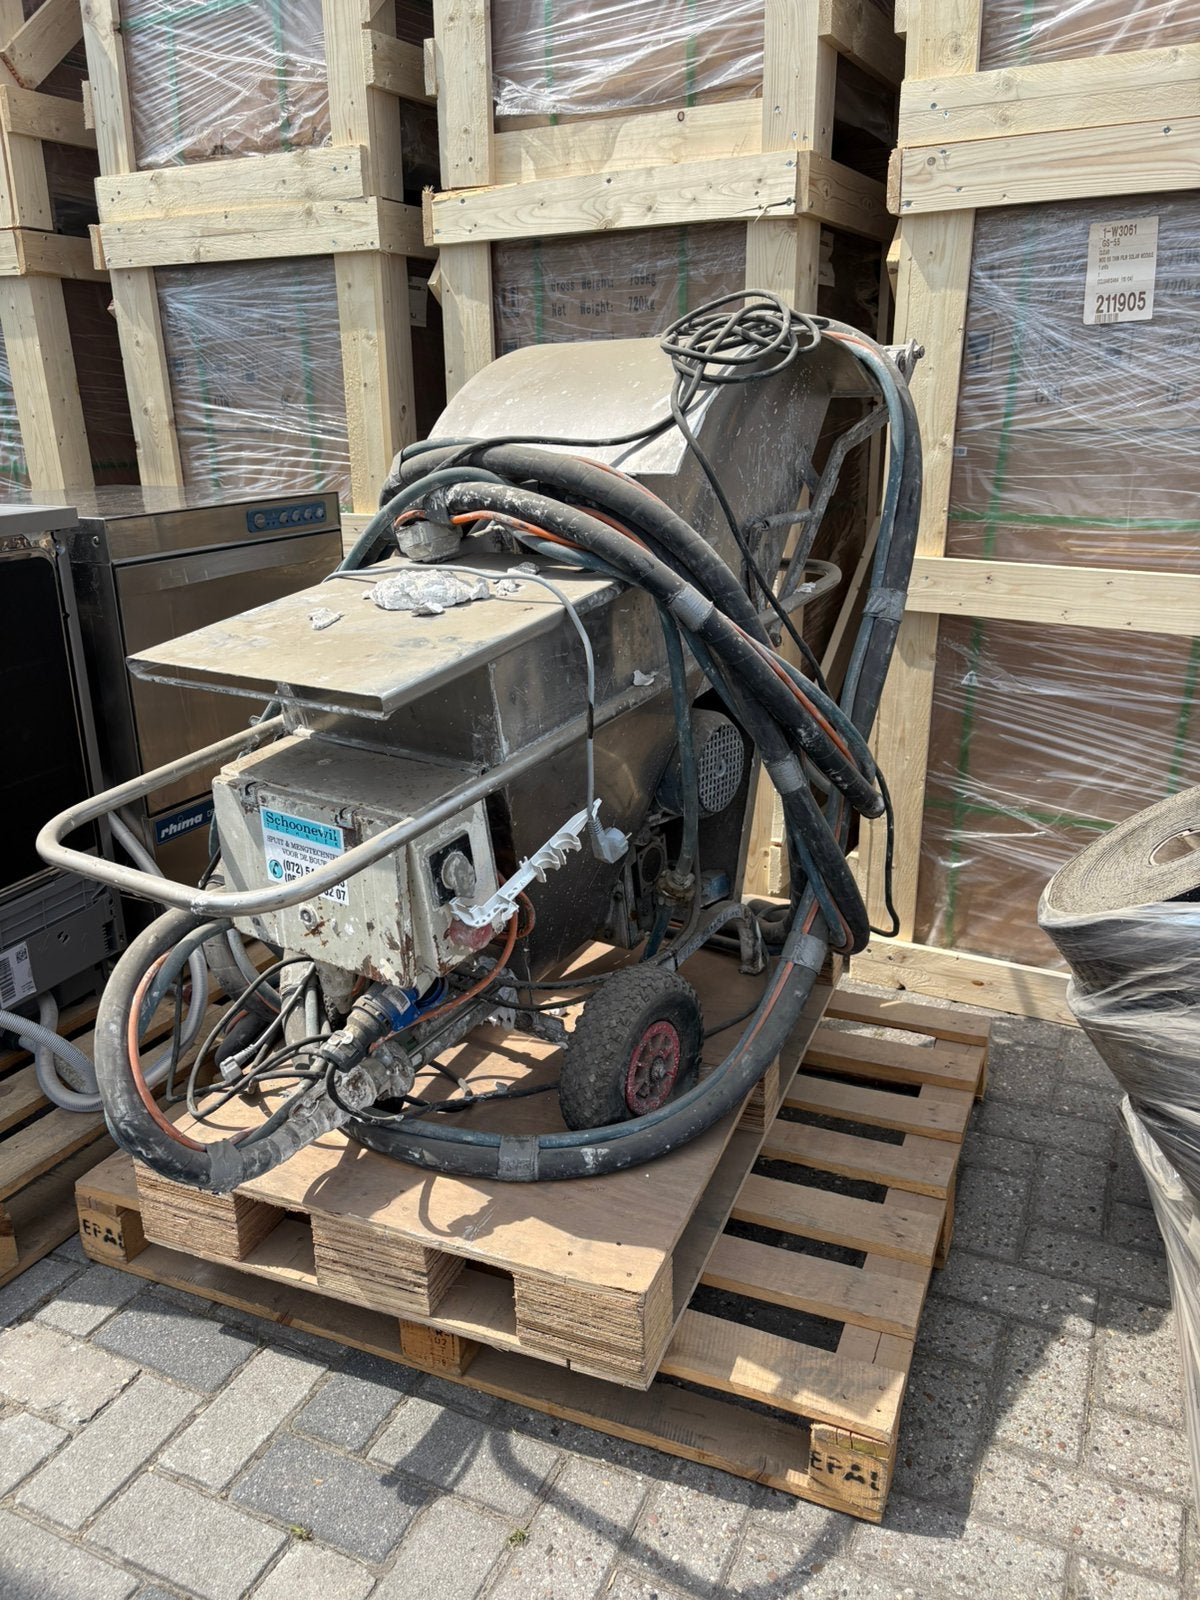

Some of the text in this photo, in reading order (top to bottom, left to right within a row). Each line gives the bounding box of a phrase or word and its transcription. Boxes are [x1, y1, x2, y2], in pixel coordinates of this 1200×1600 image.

[551, 302, 566, 317] Net
[1095, 291, 1147, 314] 211905
[161, 813, 203, 839] rhima
[265, 811, 338, 842] Schoonewil
[299, 853, 308, 861] DE
[283, 859, 304, 877] (072)
